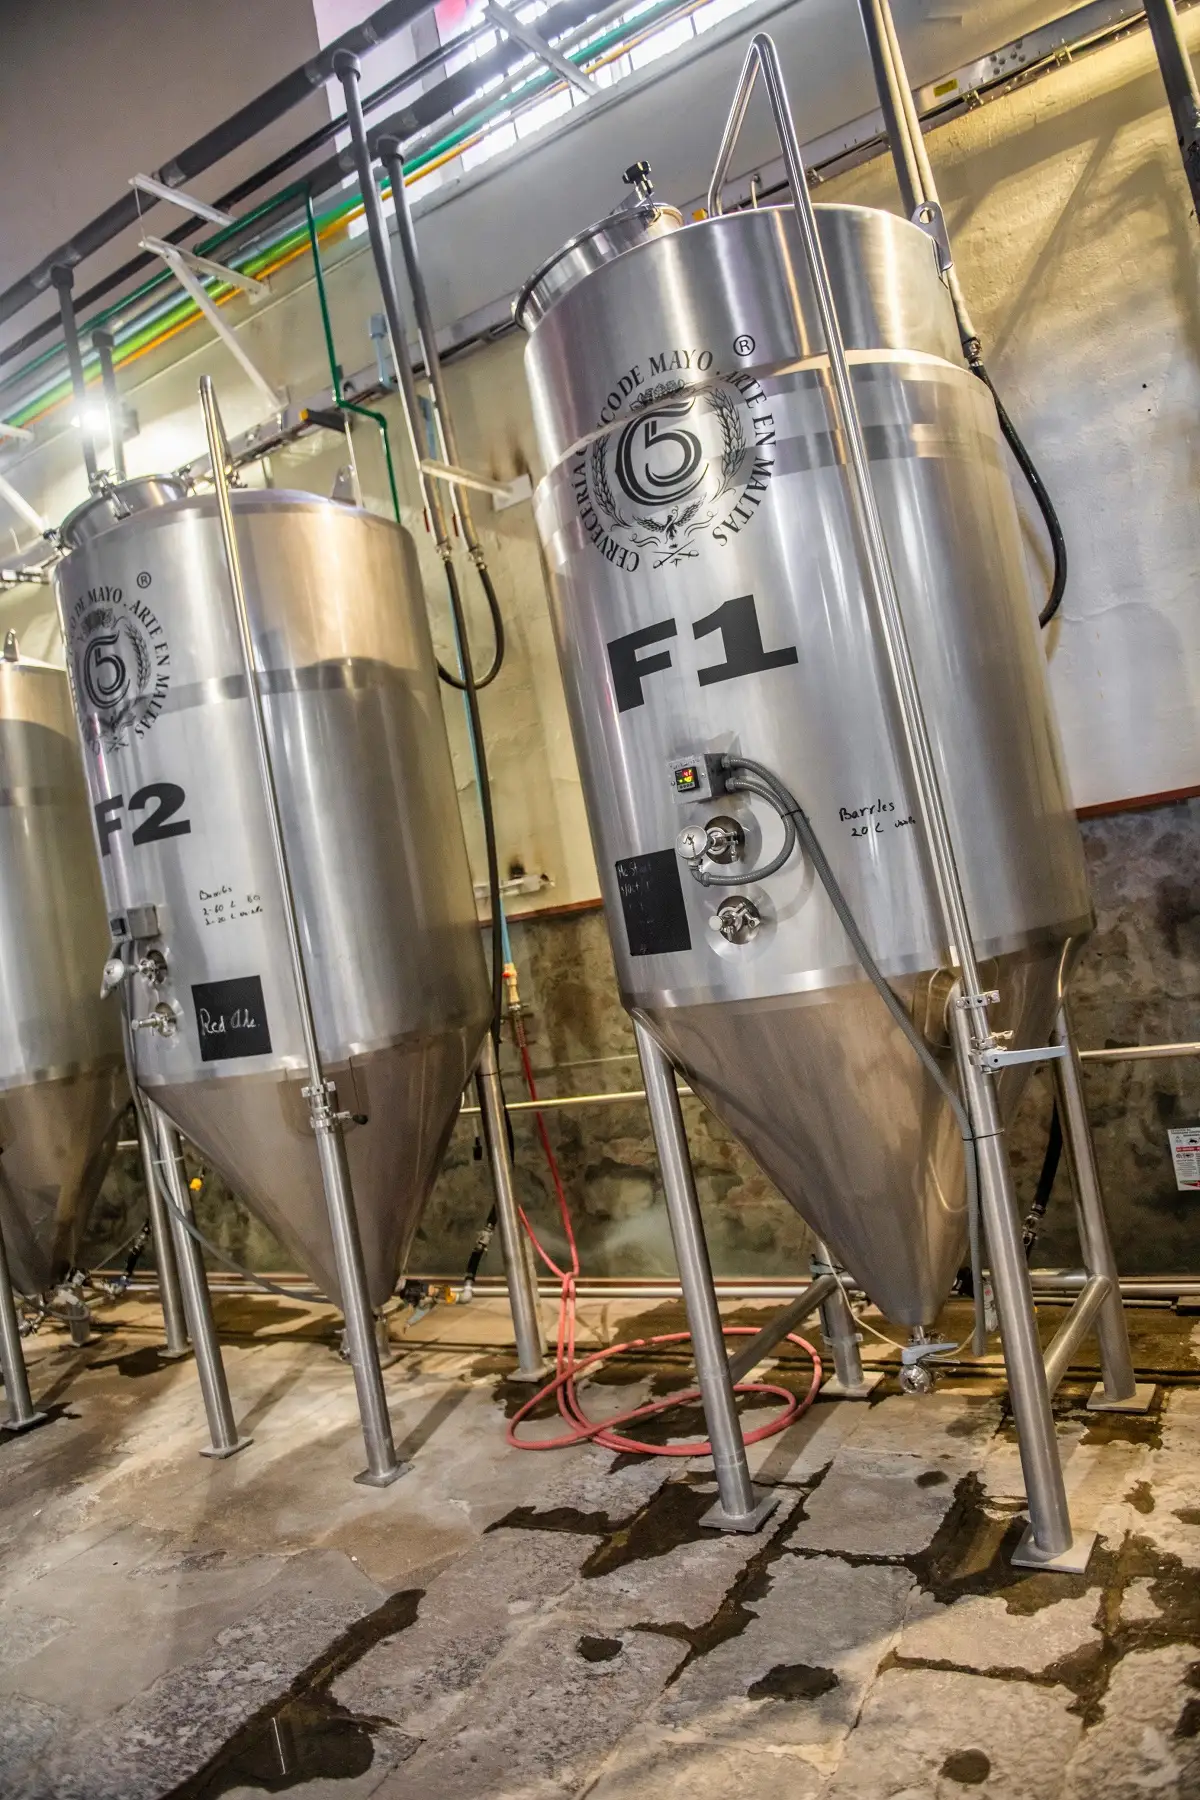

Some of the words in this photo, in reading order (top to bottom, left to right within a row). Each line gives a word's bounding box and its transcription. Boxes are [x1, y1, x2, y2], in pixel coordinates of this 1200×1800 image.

[649, 349, 714, 376] MAYO
[617, 365, 645, 397] DE
[721, 370, 768, 409] ARTE
[753, 412, 777, 448] EN
[712, 457, 776, 547] MALTAS
[87, 585, 123, 604] MAYO
[129, 600, 164, 640] ARTE
[154, 642, 171, 667] EN
[606, 594, 799, 713] F1
[134, 673, 171, 740] MALTAS
[94, 782, 192, 857] F2
[850, 826, 869, 837] 20
[199, 1007, 227, 1036] Red
